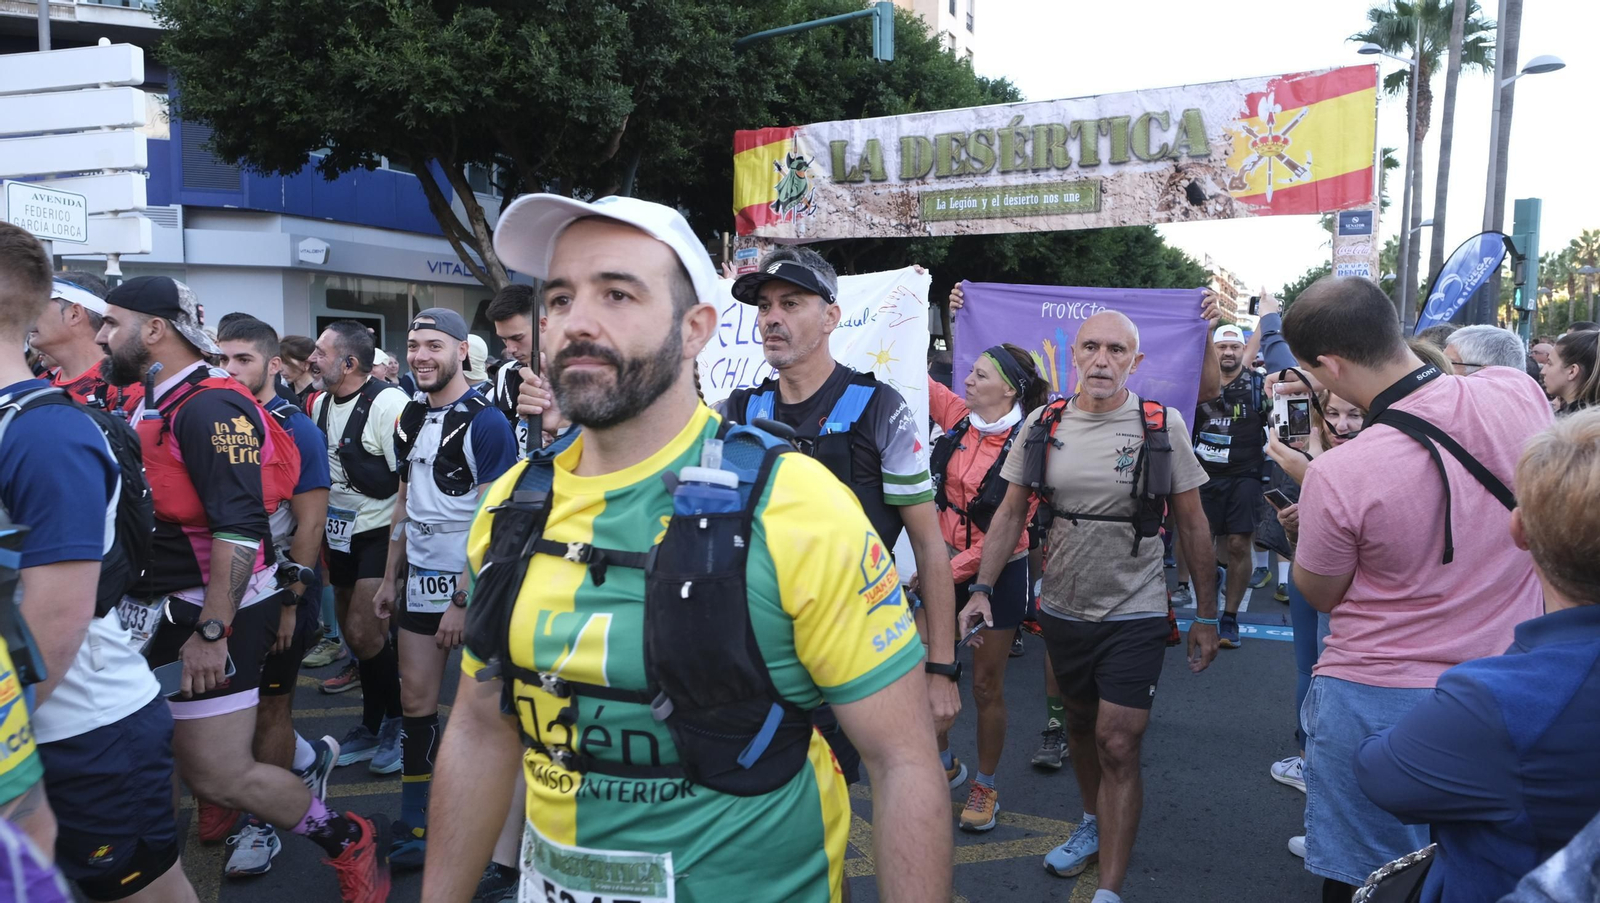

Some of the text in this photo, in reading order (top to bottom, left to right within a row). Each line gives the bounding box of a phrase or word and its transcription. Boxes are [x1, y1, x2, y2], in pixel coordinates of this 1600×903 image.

[829, 107, 1212, 184] LA DESÉRTICA
[32, 193, 82, 208] AVENIDA
[936, 192, 1080, 211] La Legión y el desierto nos une
[25, 204, 71, 222] FEDERICO
[52, 222, 82, 238] LORCA
[1416, 367, 1437, 381] SONY
[214, 422, 230, 435] LA
[228, 445, 261, 465] Eric
[327, 519, 347, 535] 537
[419, 575, 457, 595] 1061
[577, 777, 698, 804] INTERIOR
